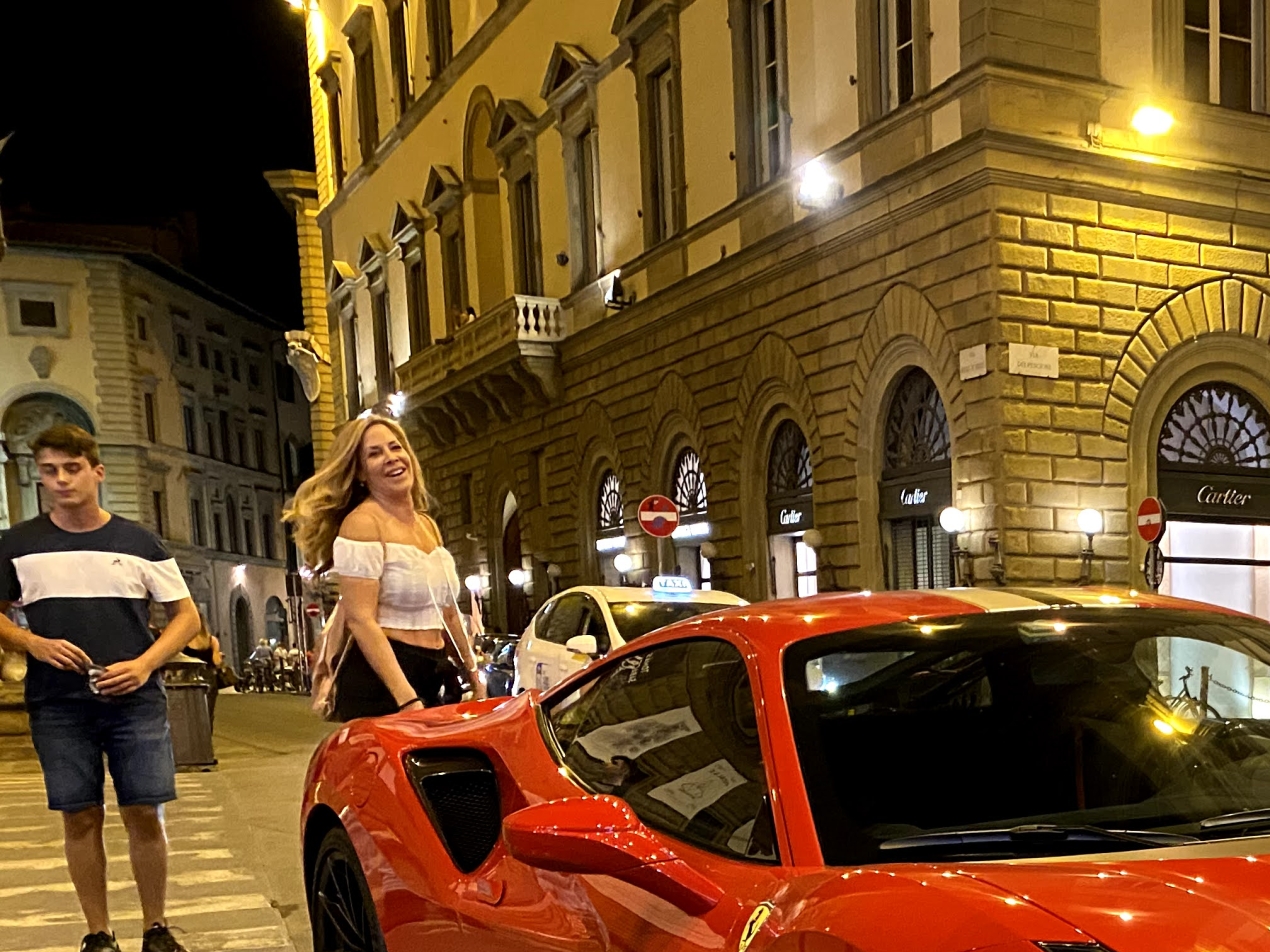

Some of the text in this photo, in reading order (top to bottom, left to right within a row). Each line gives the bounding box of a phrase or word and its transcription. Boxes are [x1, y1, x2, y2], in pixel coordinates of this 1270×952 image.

[900, 488, 928, 505] Cartier
[1197, 484, 1252, 506] Cartier
[780, 509, 802, 525] Cartier
